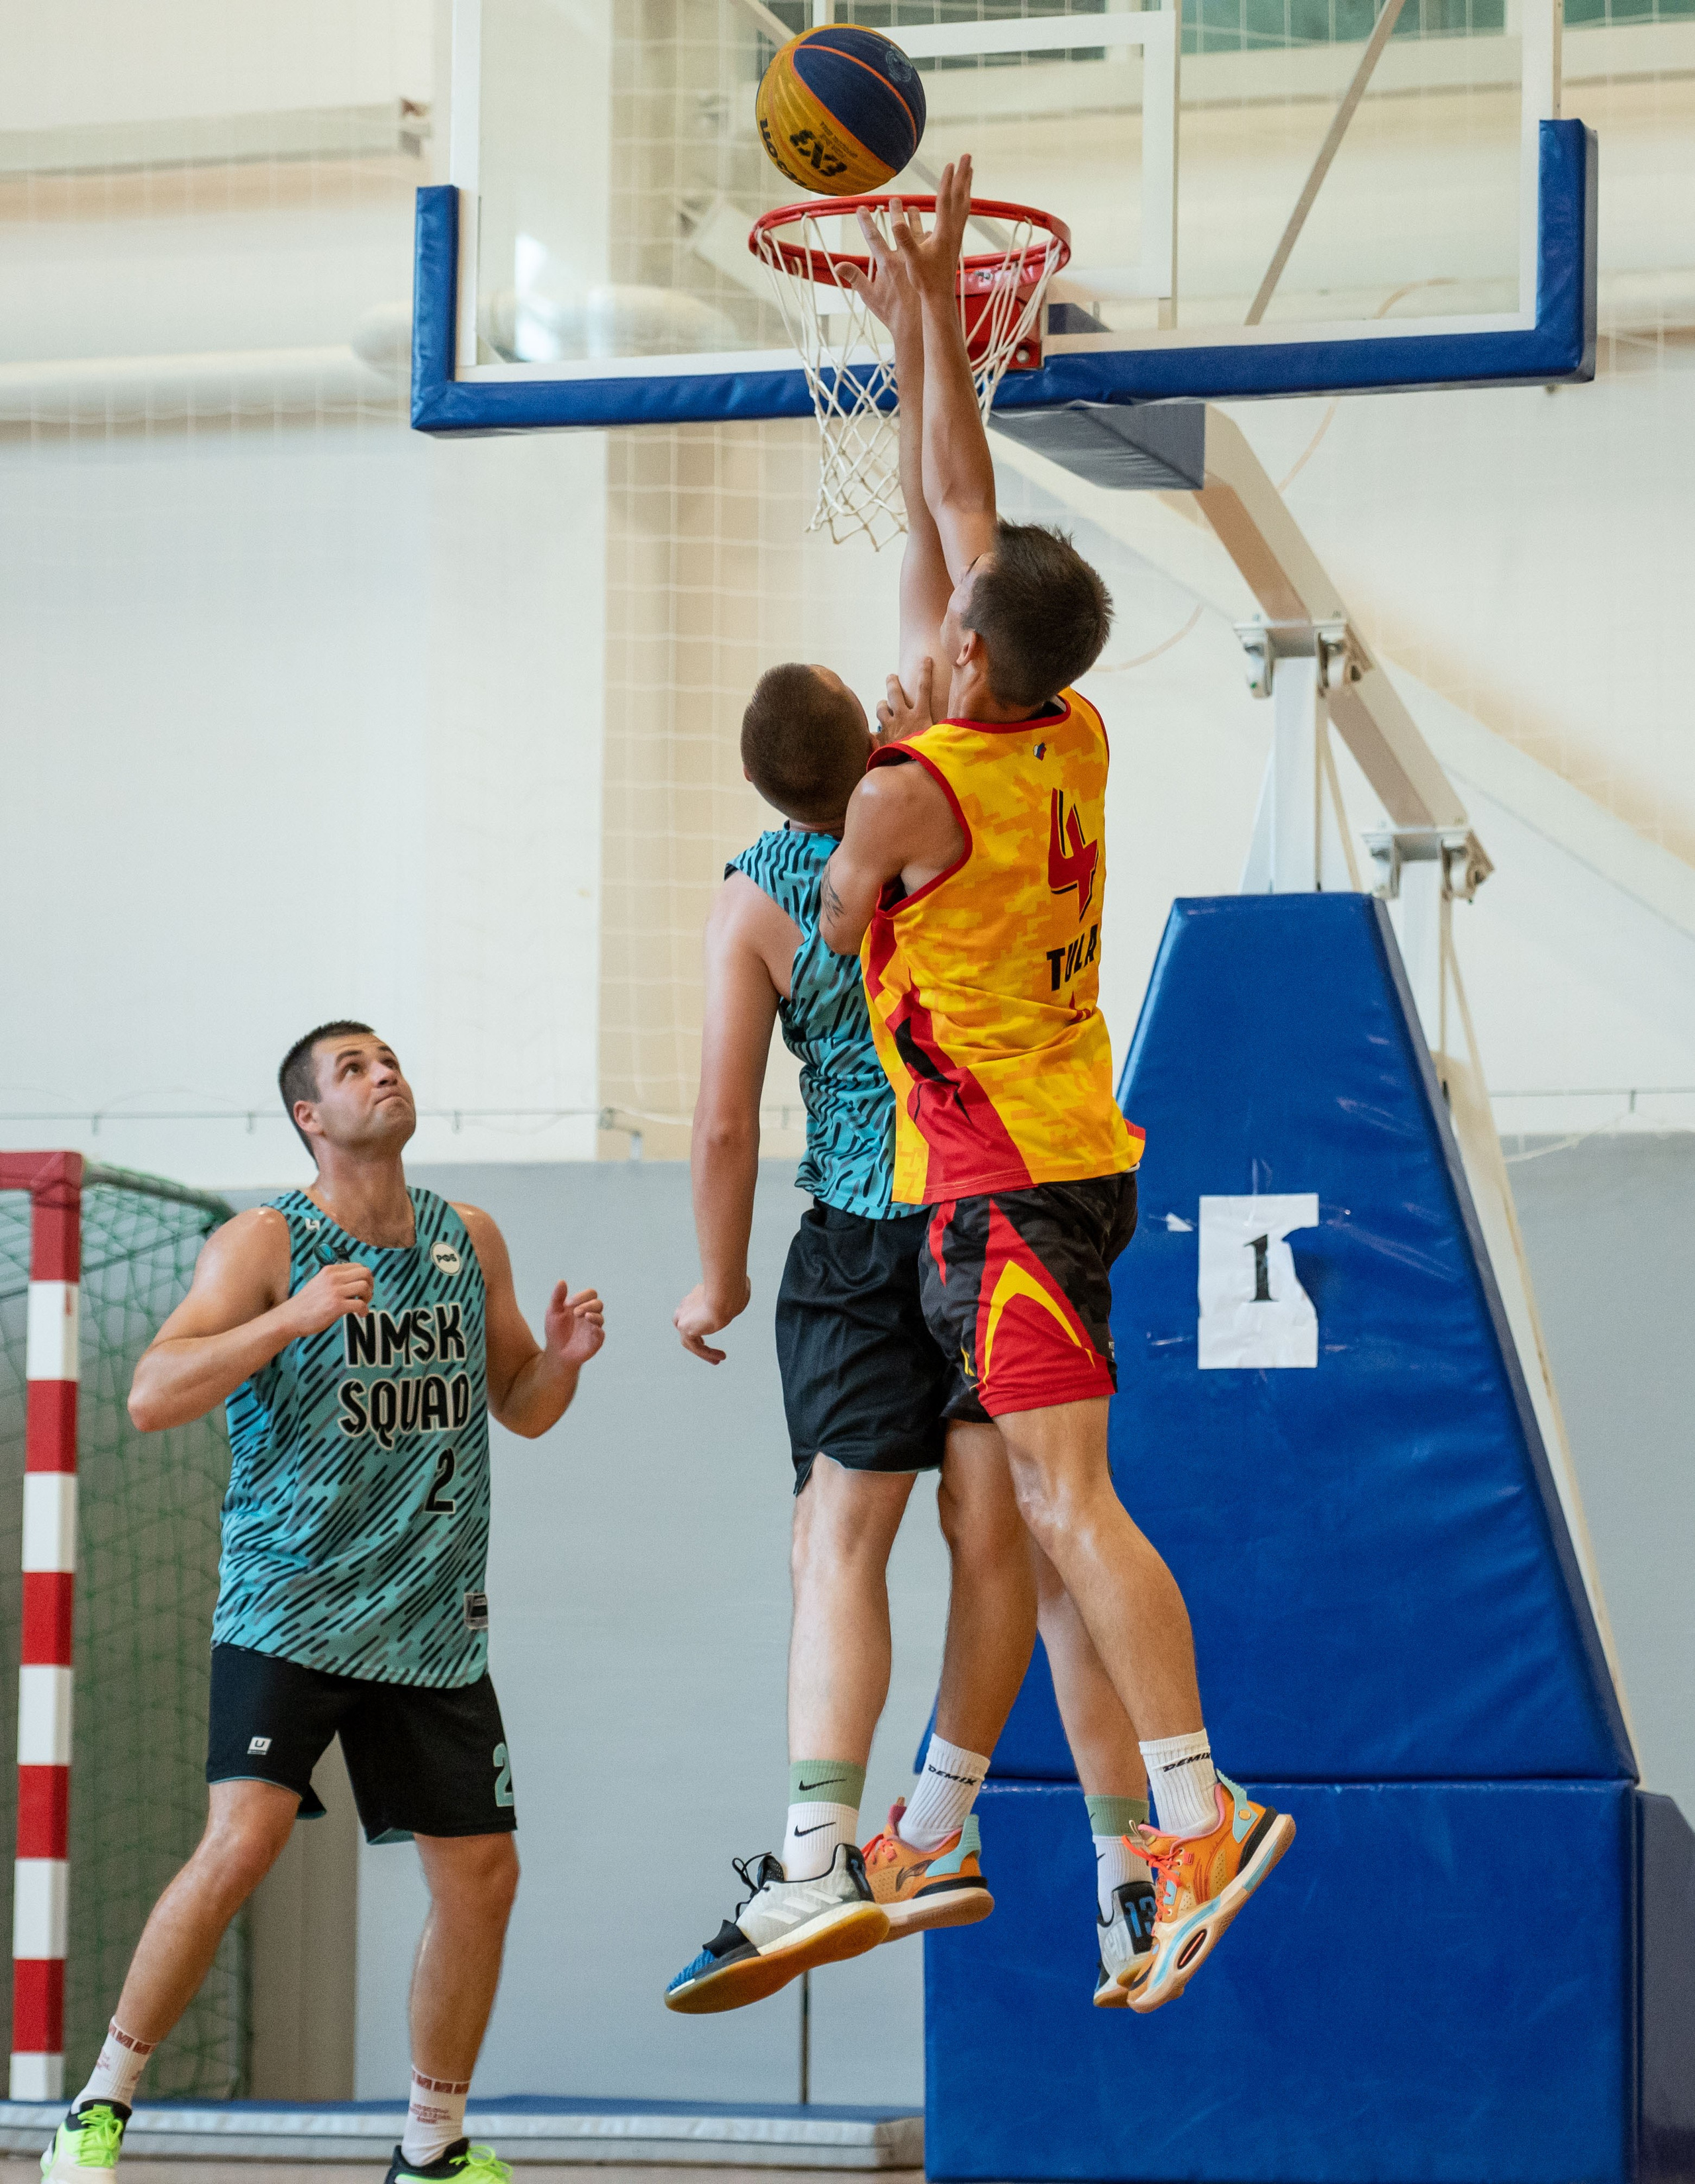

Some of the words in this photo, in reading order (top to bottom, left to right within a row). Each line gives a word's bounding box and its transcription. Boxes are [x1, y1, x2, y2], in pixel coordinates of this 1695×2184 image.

[1048, 788, 1099, 924] 4
[1046, 924, 1098, 992] TULA
[1243, 1233, 1281, 1303] 1
[344, 1302, 467, 1368] NMSK
[338, 1370, 471, 1451] SQUAD
[424, 1447, 456, 1514] 2
[493, 1742, 515, 1807] 2
[928, 1764, 977, 1786] DEMIX
[1163, 1752, 1211, 1773] DEMIX
